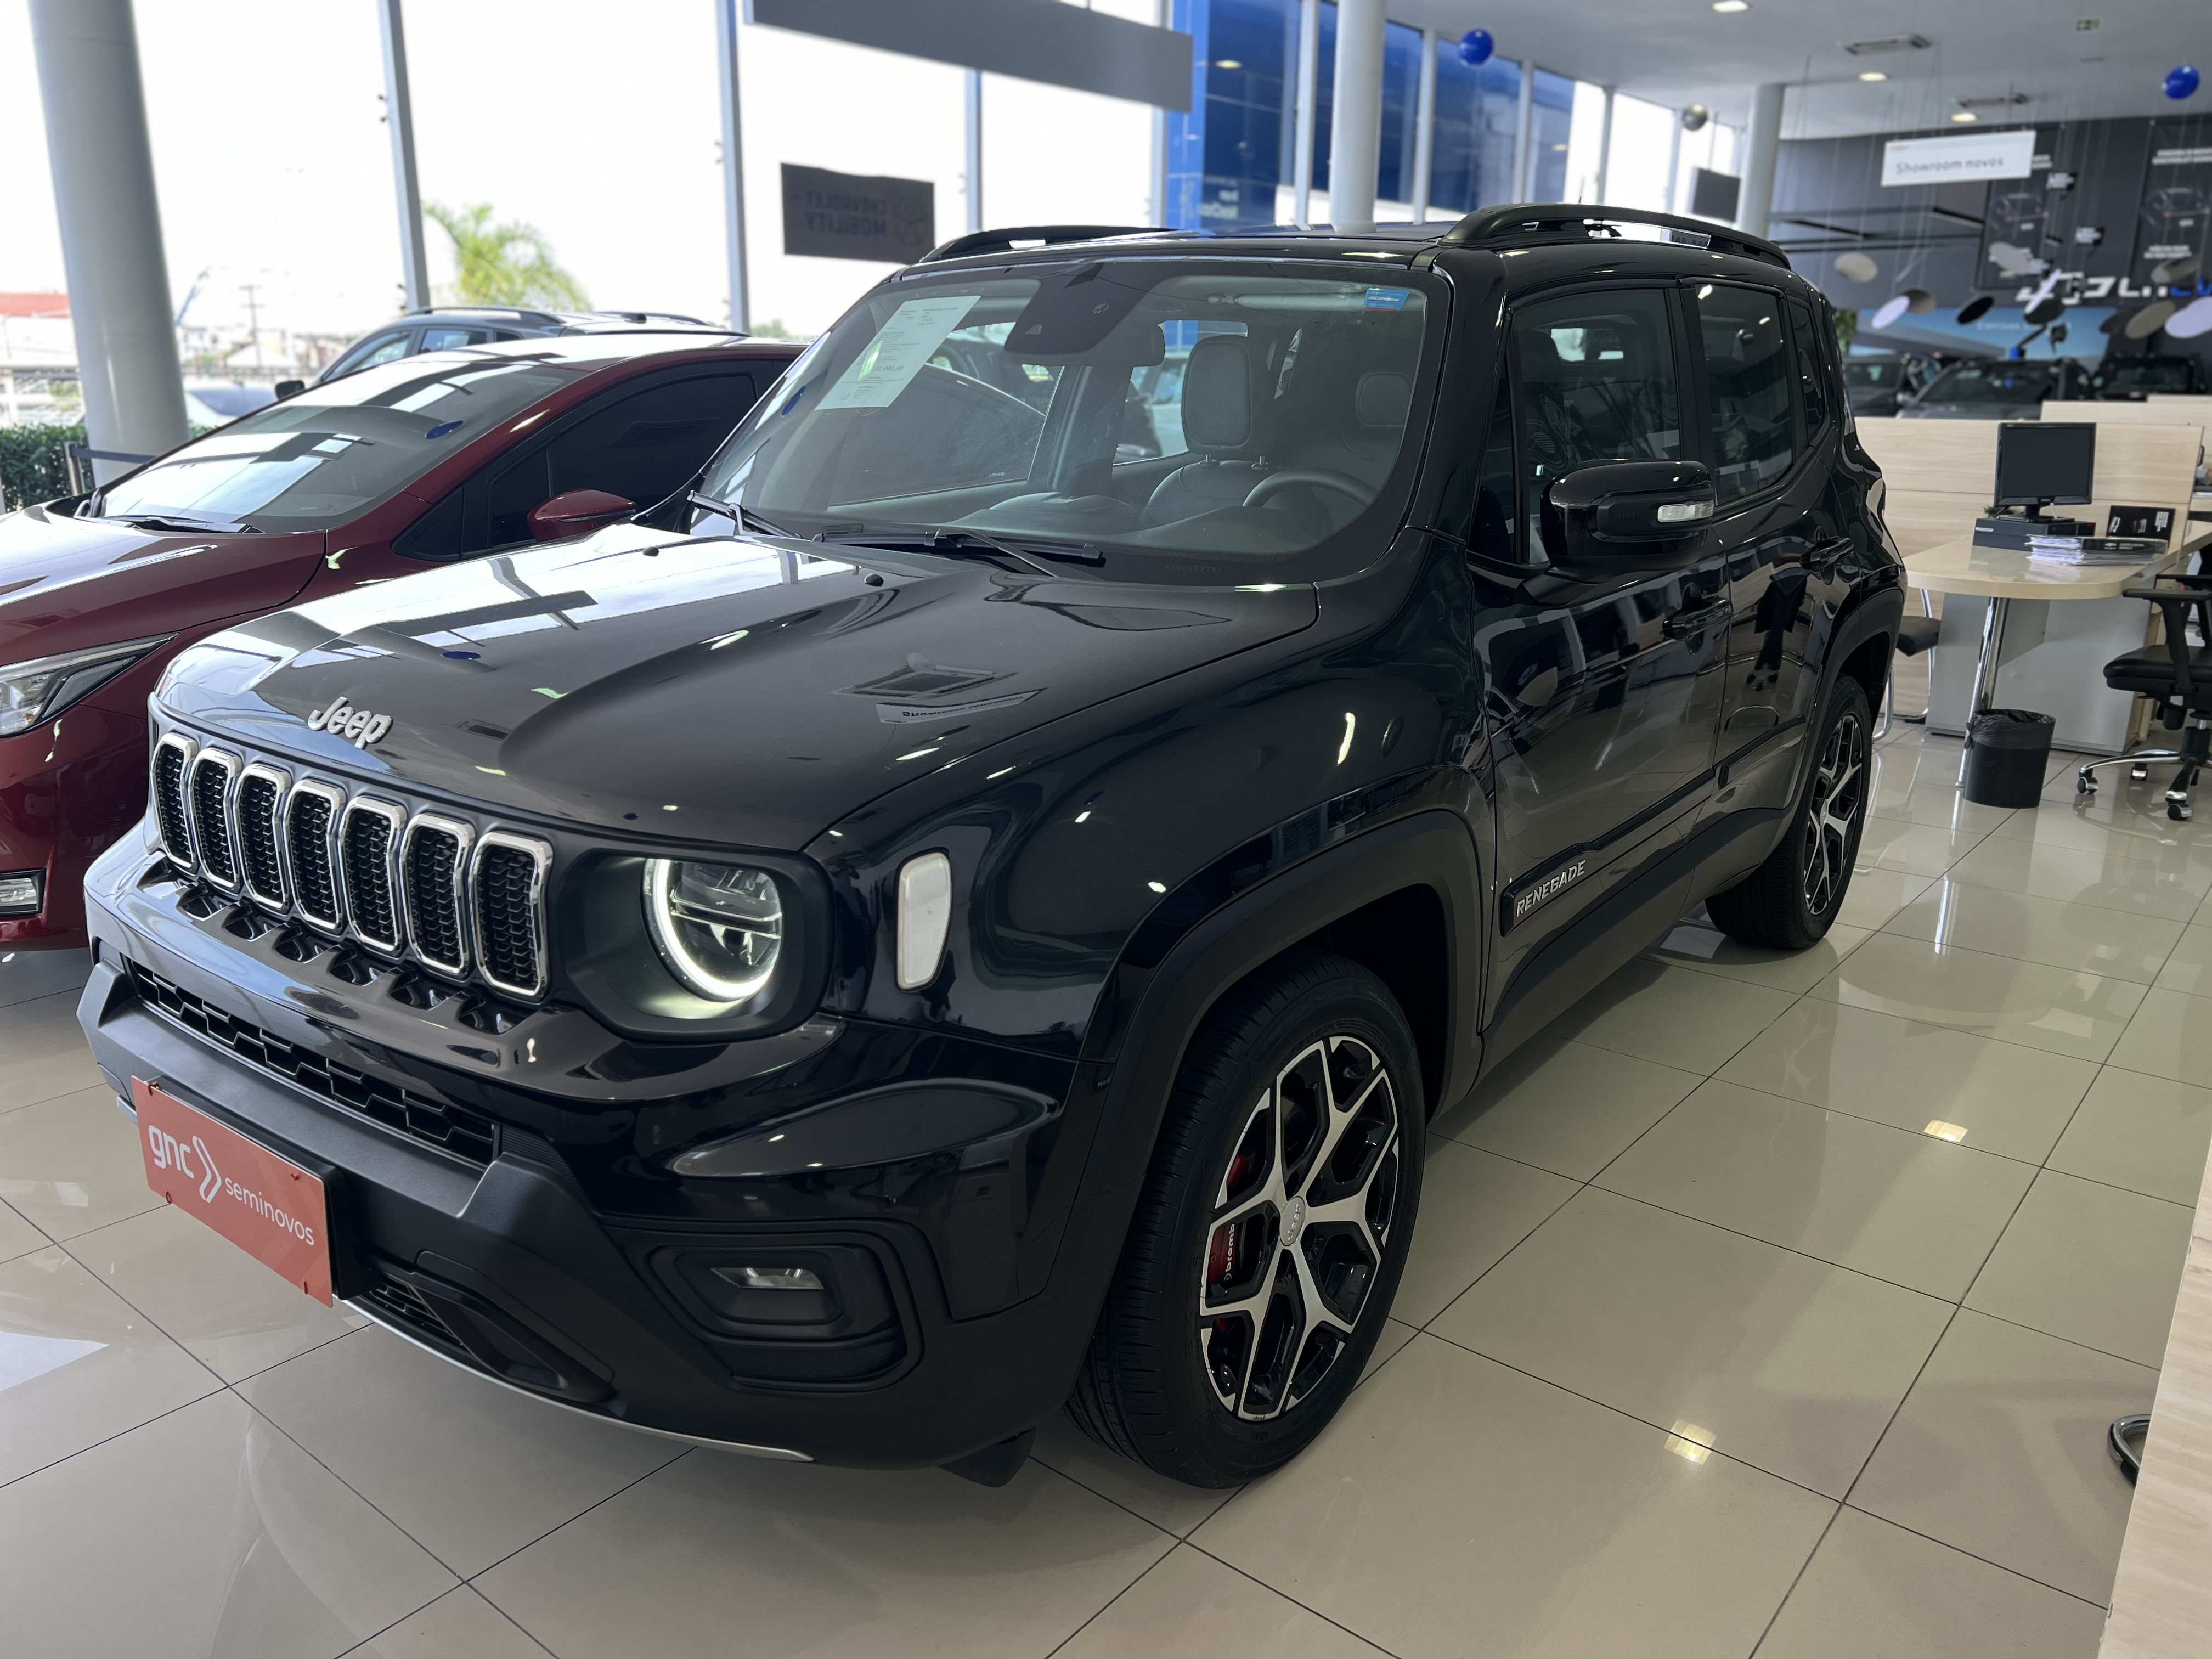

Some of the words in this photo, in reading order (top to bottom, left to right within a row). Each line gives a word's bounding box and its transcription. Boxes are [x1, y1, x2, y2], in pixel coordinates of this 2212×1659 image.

[1896, 160, 1962, 174] Showroom
[1965, 157, 2004, 168] novos
[308, 696, 392, 749] Jeep
[1516, 860, 1585, 917] RENEGADE
[148, 1125, 194, 1180] gnc
[224, 1177, 314, 1246] seminovos
[1224, 1223, 1235, 1272] bremb
